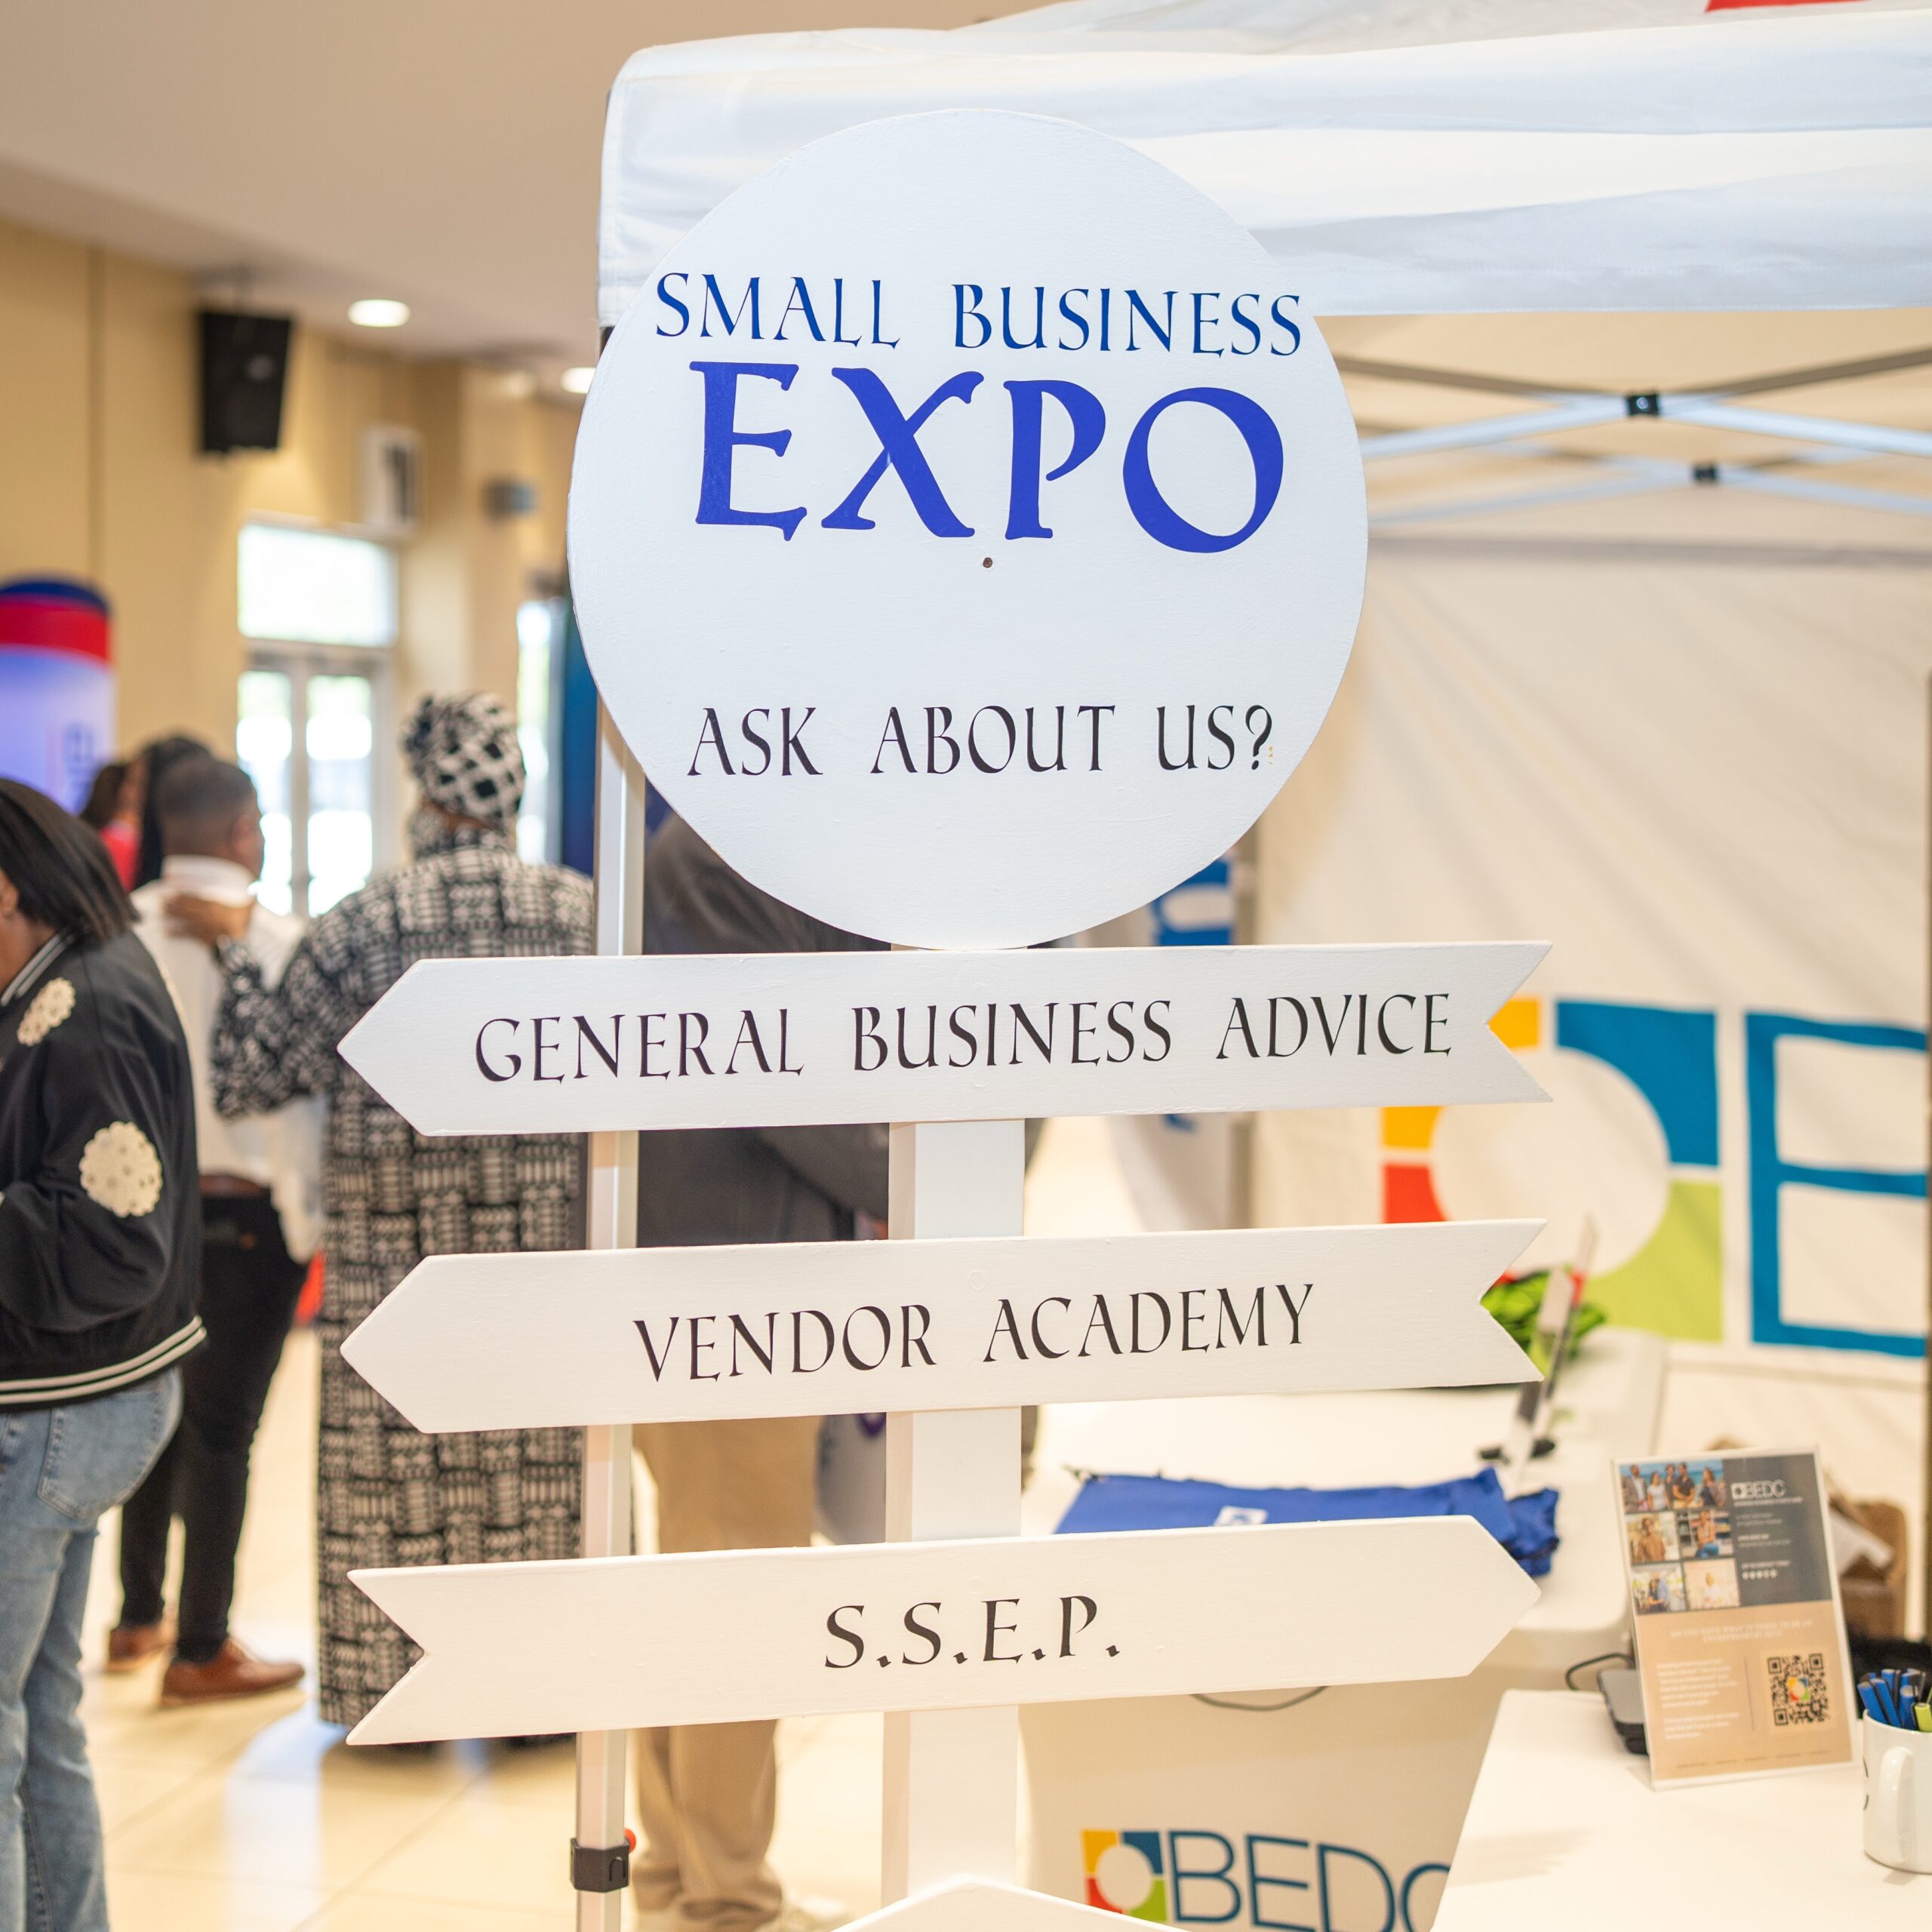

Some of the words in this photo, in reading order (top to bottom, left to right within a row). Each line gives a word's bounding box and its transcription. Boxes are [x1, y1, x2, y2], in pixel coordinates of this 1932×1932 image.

[655, 272, 901, 350] SMALL
[952, 284, 1302, 358] BUSINESS
[689, 360, 1284, 554] EXPO
[687, 706, 823, 777] ASK
[870, 705, 1115, 775] ABOUT
[1156, 704, 1273, 771] US?
[475, 1008, 804, 1084] GENERAL
[851, 1000, 1171, 1072] BUSINESS
[1215, 992, 1452, 1060] ADVICE
[633, 1303, 937, 1382] VENDOR
[983, 1284, 1314, 1363] ACADEMY
[825, 1595, 1121, 1669] S.S.E.P.
